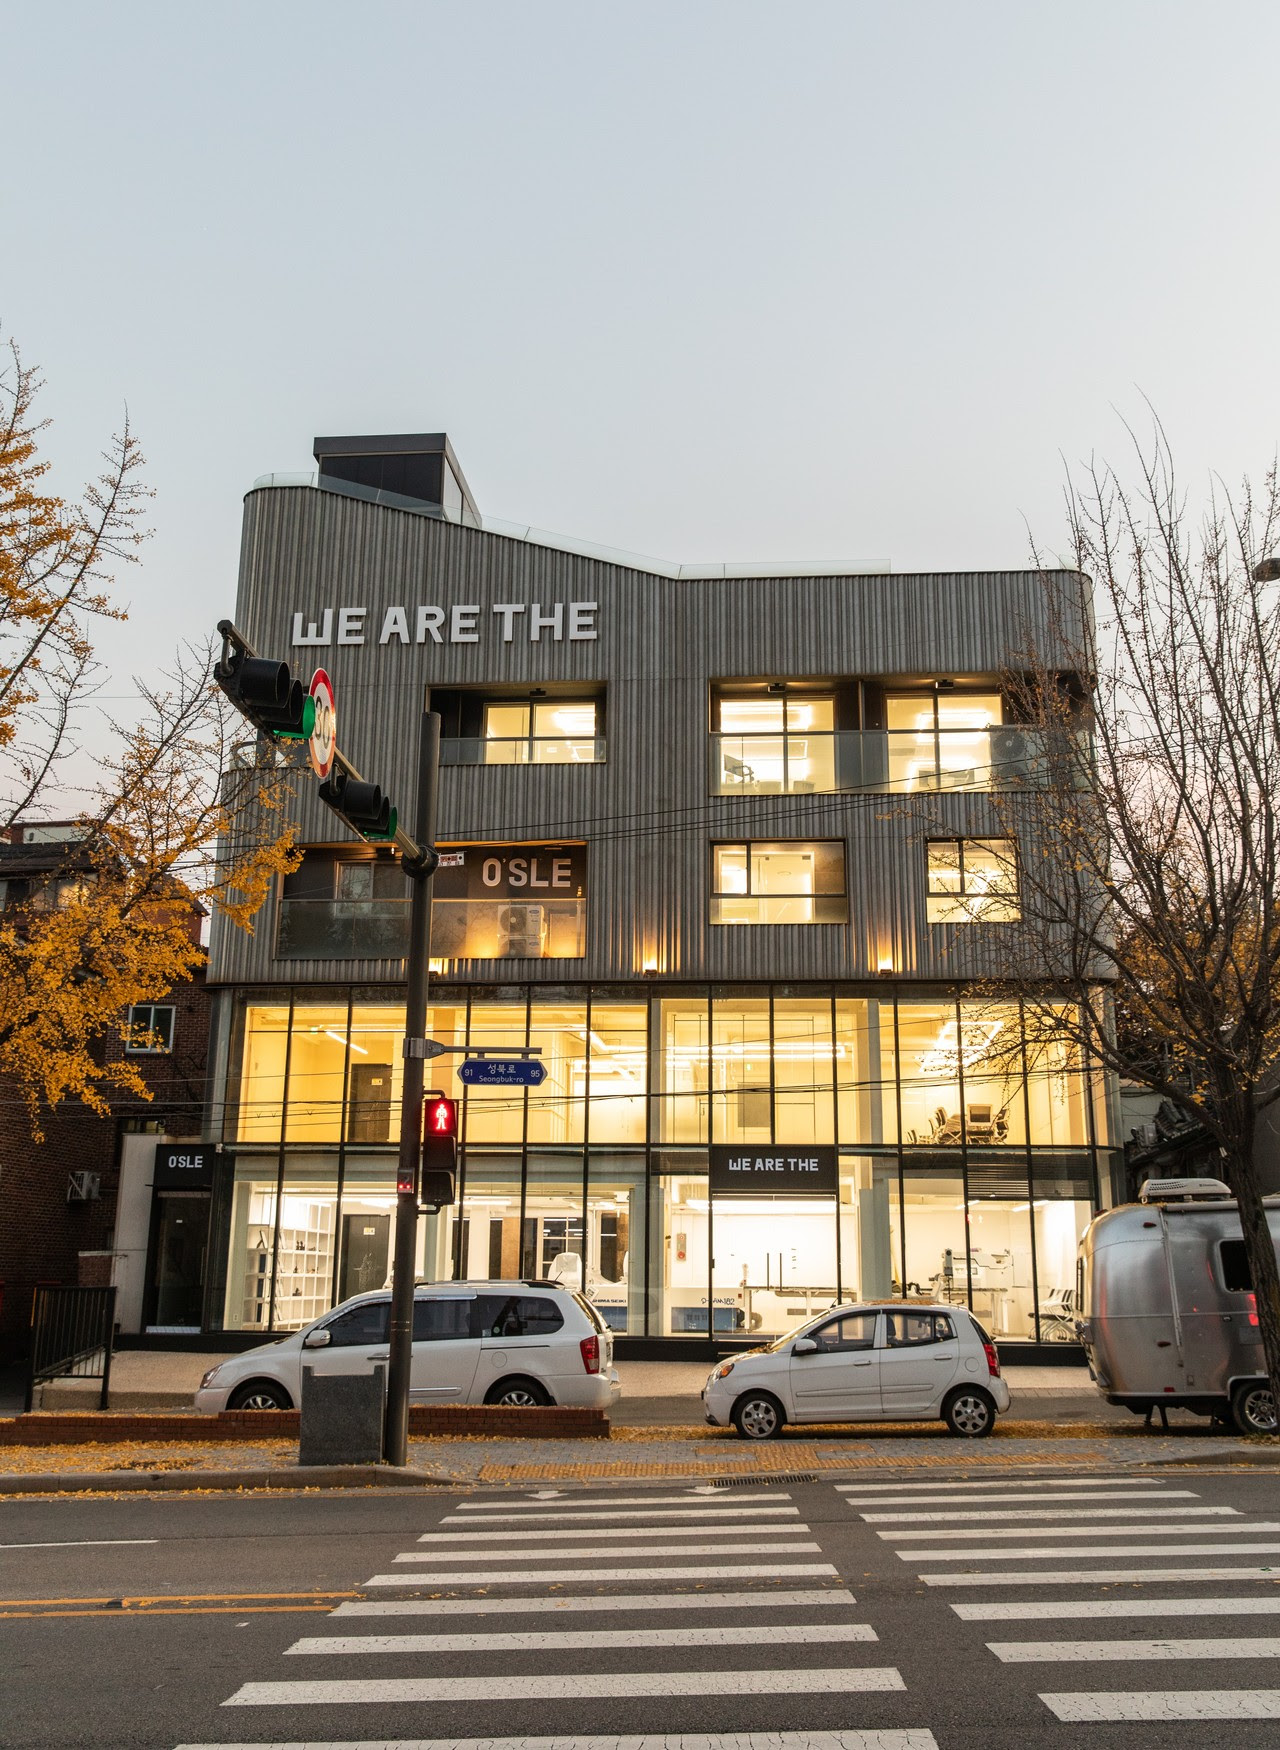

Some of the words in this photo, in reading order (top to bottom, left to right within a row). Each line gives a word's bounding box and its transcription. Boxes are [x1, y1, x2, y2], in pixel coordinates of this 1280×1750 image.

[292, 608, 367, 646] WE
[379, 605, 480, 645] ARE
[493, 602, 598, 642] THE
[315, 695, 330, 749] 30
[482, 858, 571, 887] O'SLE
[464, 1068, 473, 1076] 91
[487, 1063, 516, 1075] 성북로
[530, 1069, 540, 1078] 95
[478, 1075, 524, 1084] Seongbuk-ro
[168, 1155, 203, 1168] O'SLE
[728, 1158, 752, 1171] WE
[754, 1158, 785, 1171] ARE
[787, 1158, 819, 1171] THE
